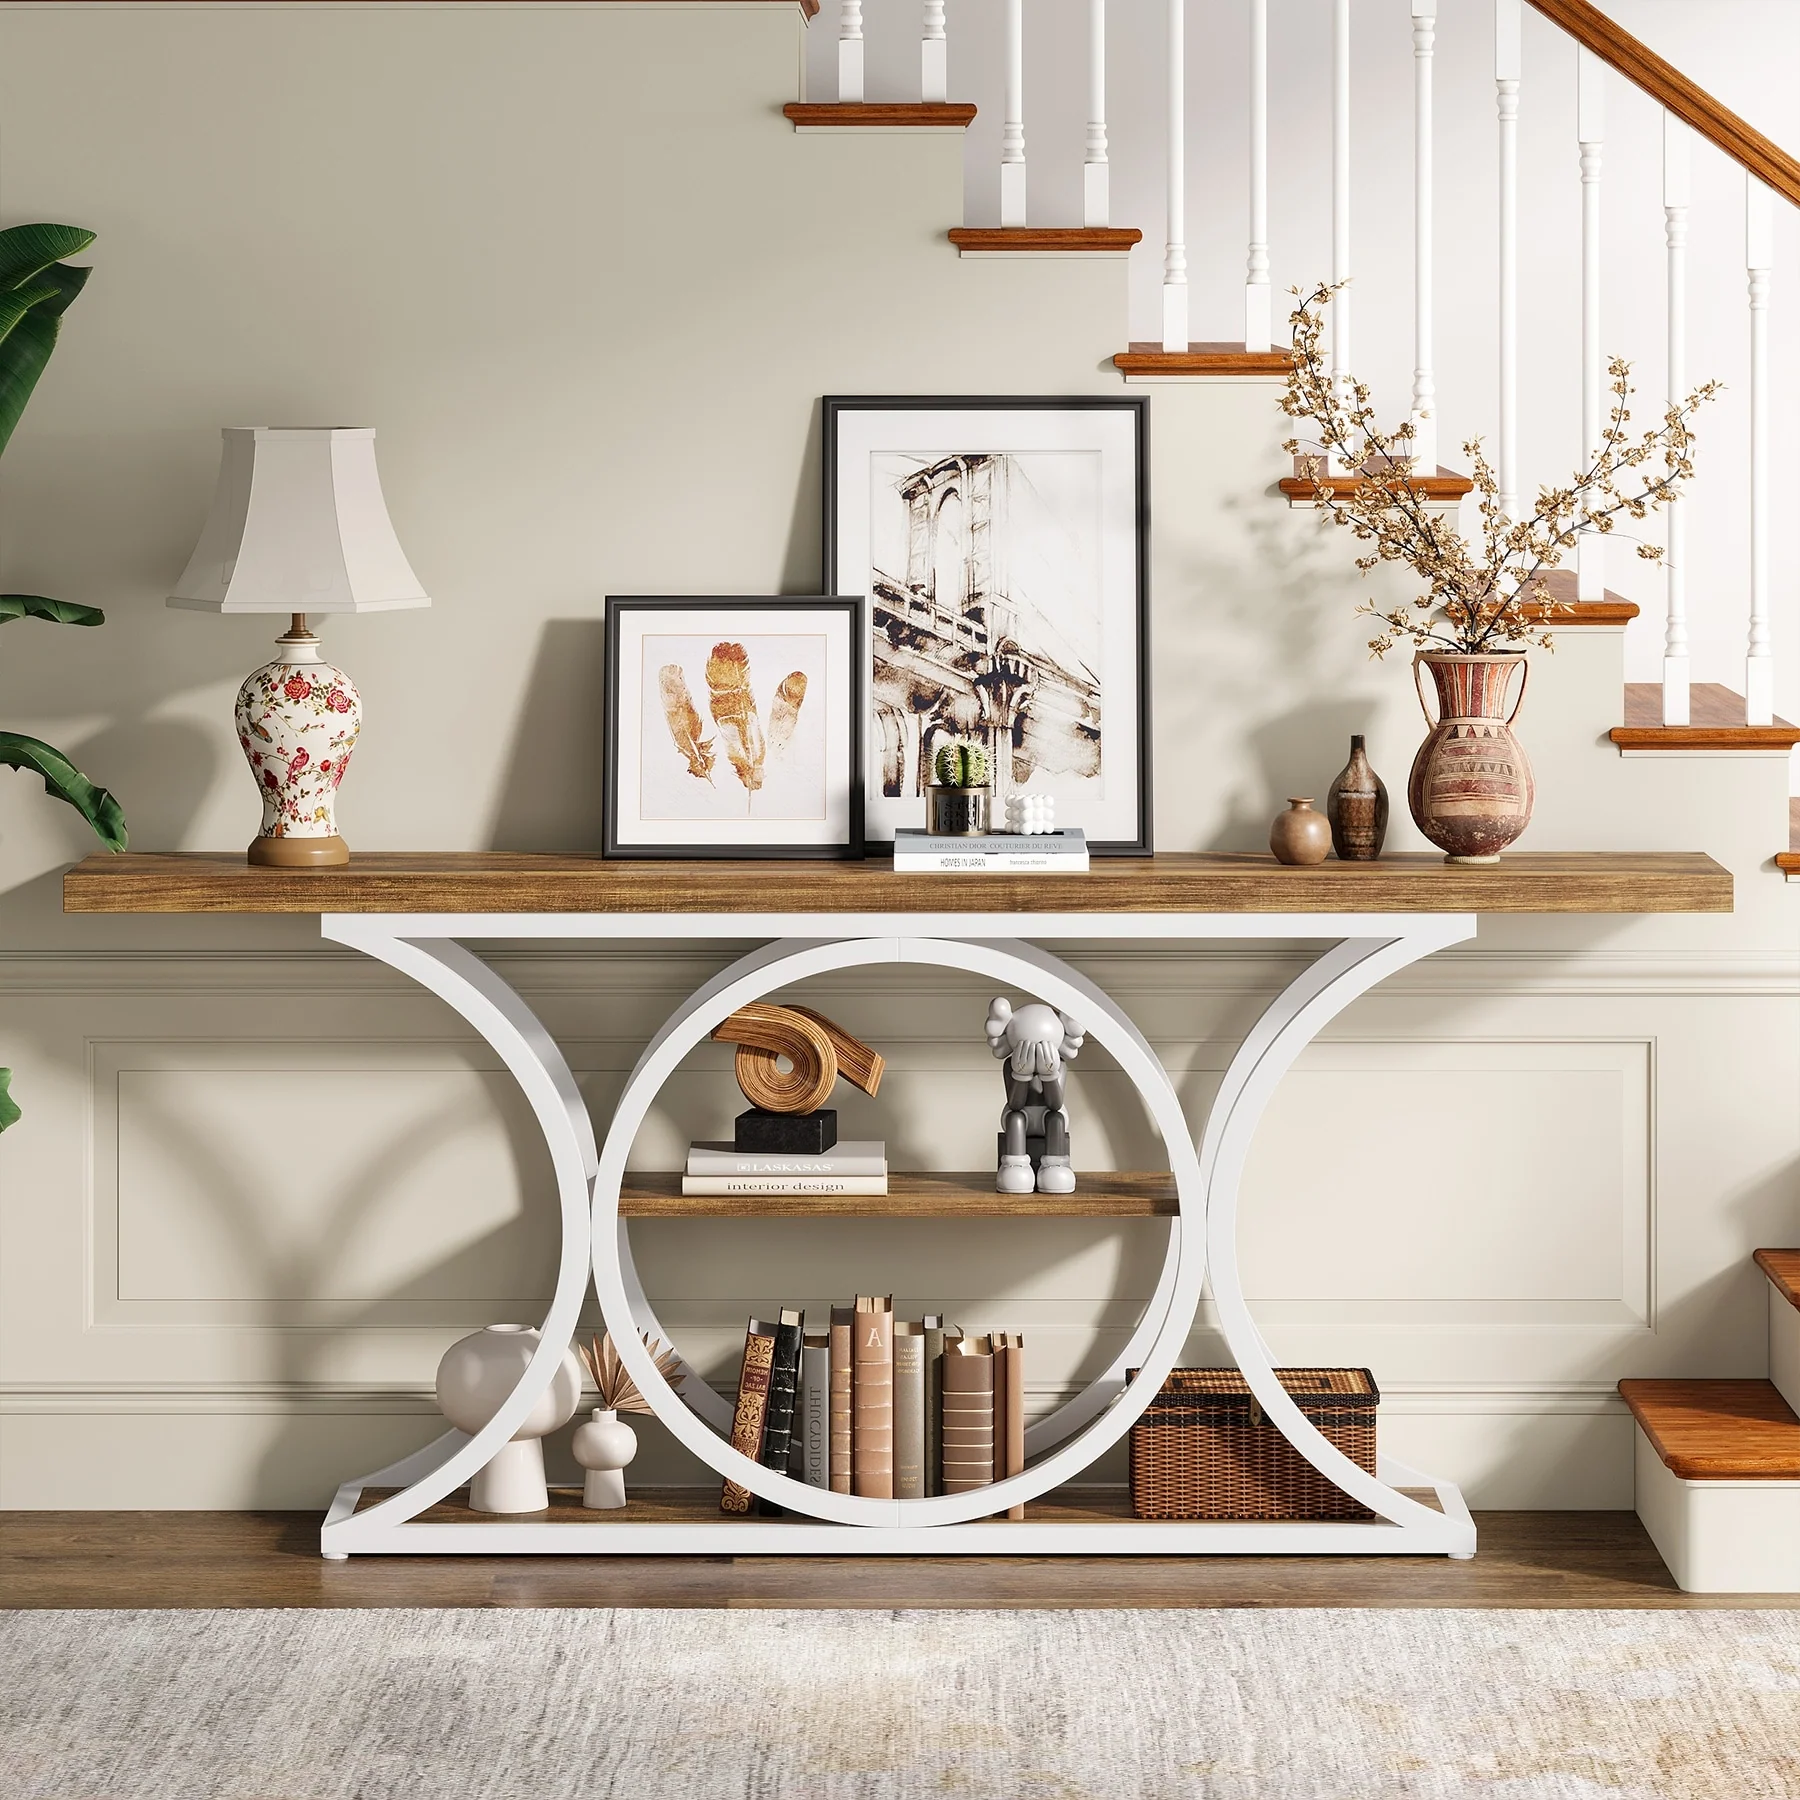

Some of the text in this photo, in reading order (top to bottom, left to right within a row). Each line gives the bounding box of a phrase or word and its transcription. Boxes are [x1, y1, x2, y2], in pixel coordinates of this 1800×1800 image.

[940, 858, 986, 867] HOMES IN JAPAN
[727, 1182, 845, 1192] interior design
[865, 1327, 883, 1347] A
